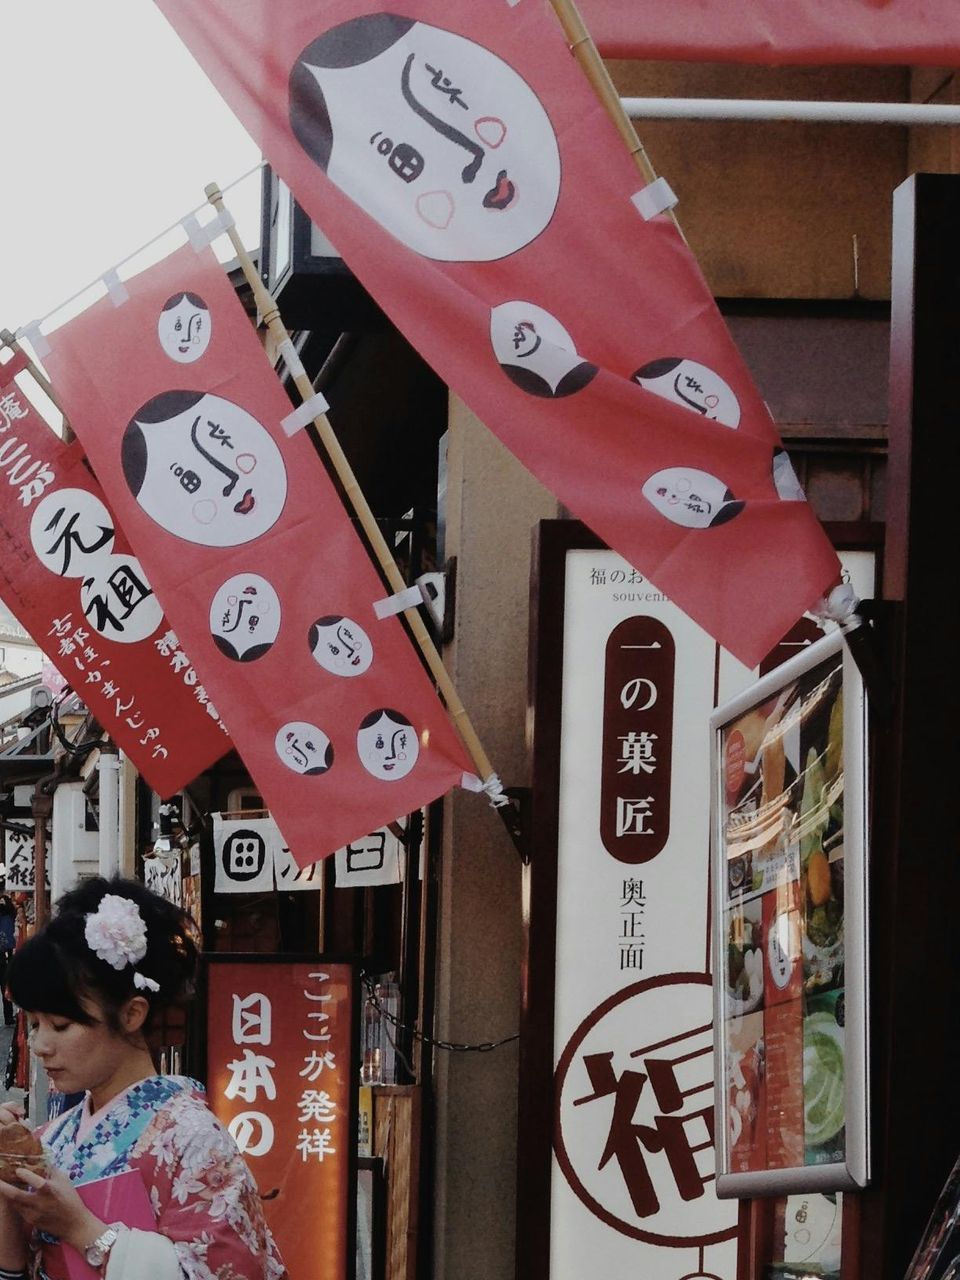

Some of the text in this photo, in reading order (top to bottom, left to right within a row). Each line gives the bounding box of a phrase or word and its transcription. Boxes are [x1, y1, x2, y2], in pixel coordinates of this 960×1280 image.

[43, 507, 154, 632] 元祖
[612, 592, 670, 602] souveni
[617, 640, 662, 838] 一の菓匠
[618, 877, 647, 970] 奥正面
[224, 992, 278, 1157] 日本の
[296, 972, 338, 1162] ここが発祥
